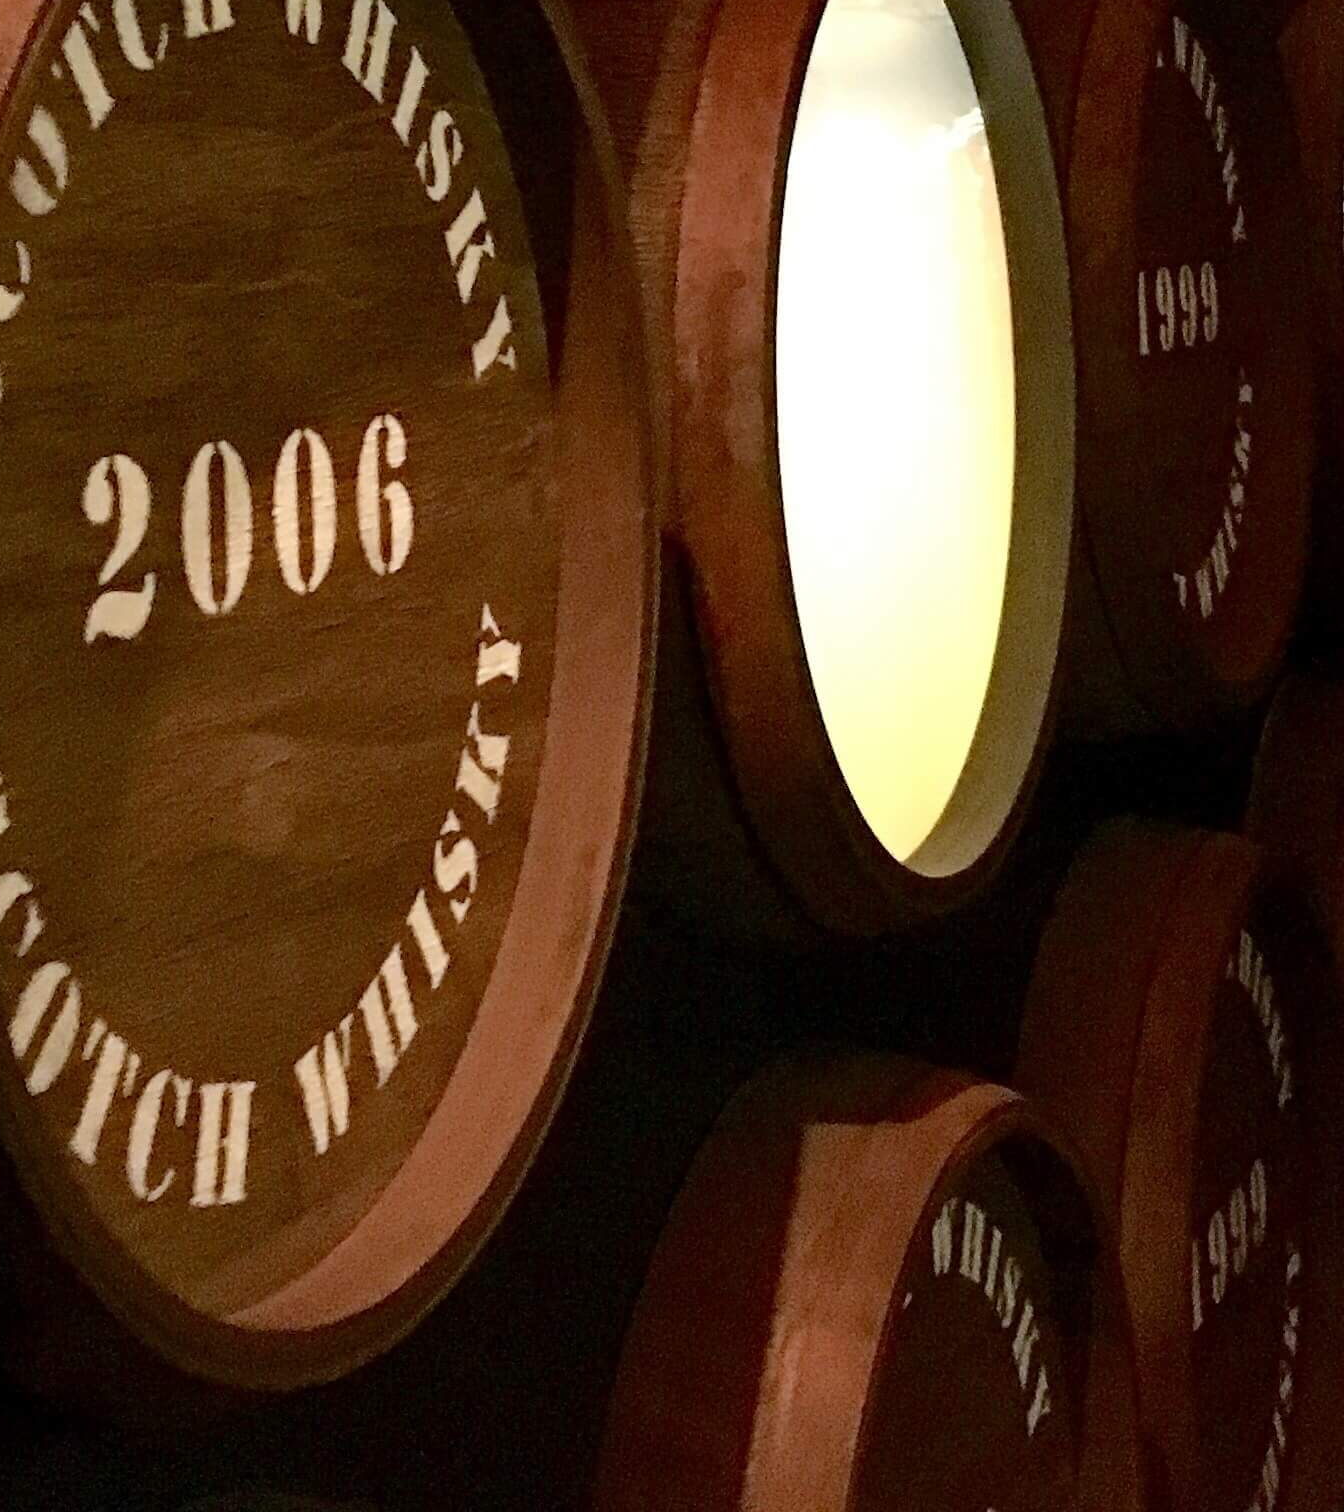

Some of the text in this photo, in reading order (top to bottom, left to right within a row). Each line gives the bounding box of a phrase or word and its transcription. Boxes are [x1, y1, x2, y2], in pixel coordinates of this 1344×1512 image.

[1138, 261, 1218, 356] 1999
[81, 412, 414, 644] 2006
[293, 602, 523, 1156] WHISKY
[930, 1196, 1052, 1438] WHISKY
[1191, 1157, 1268, 1332] 1999
